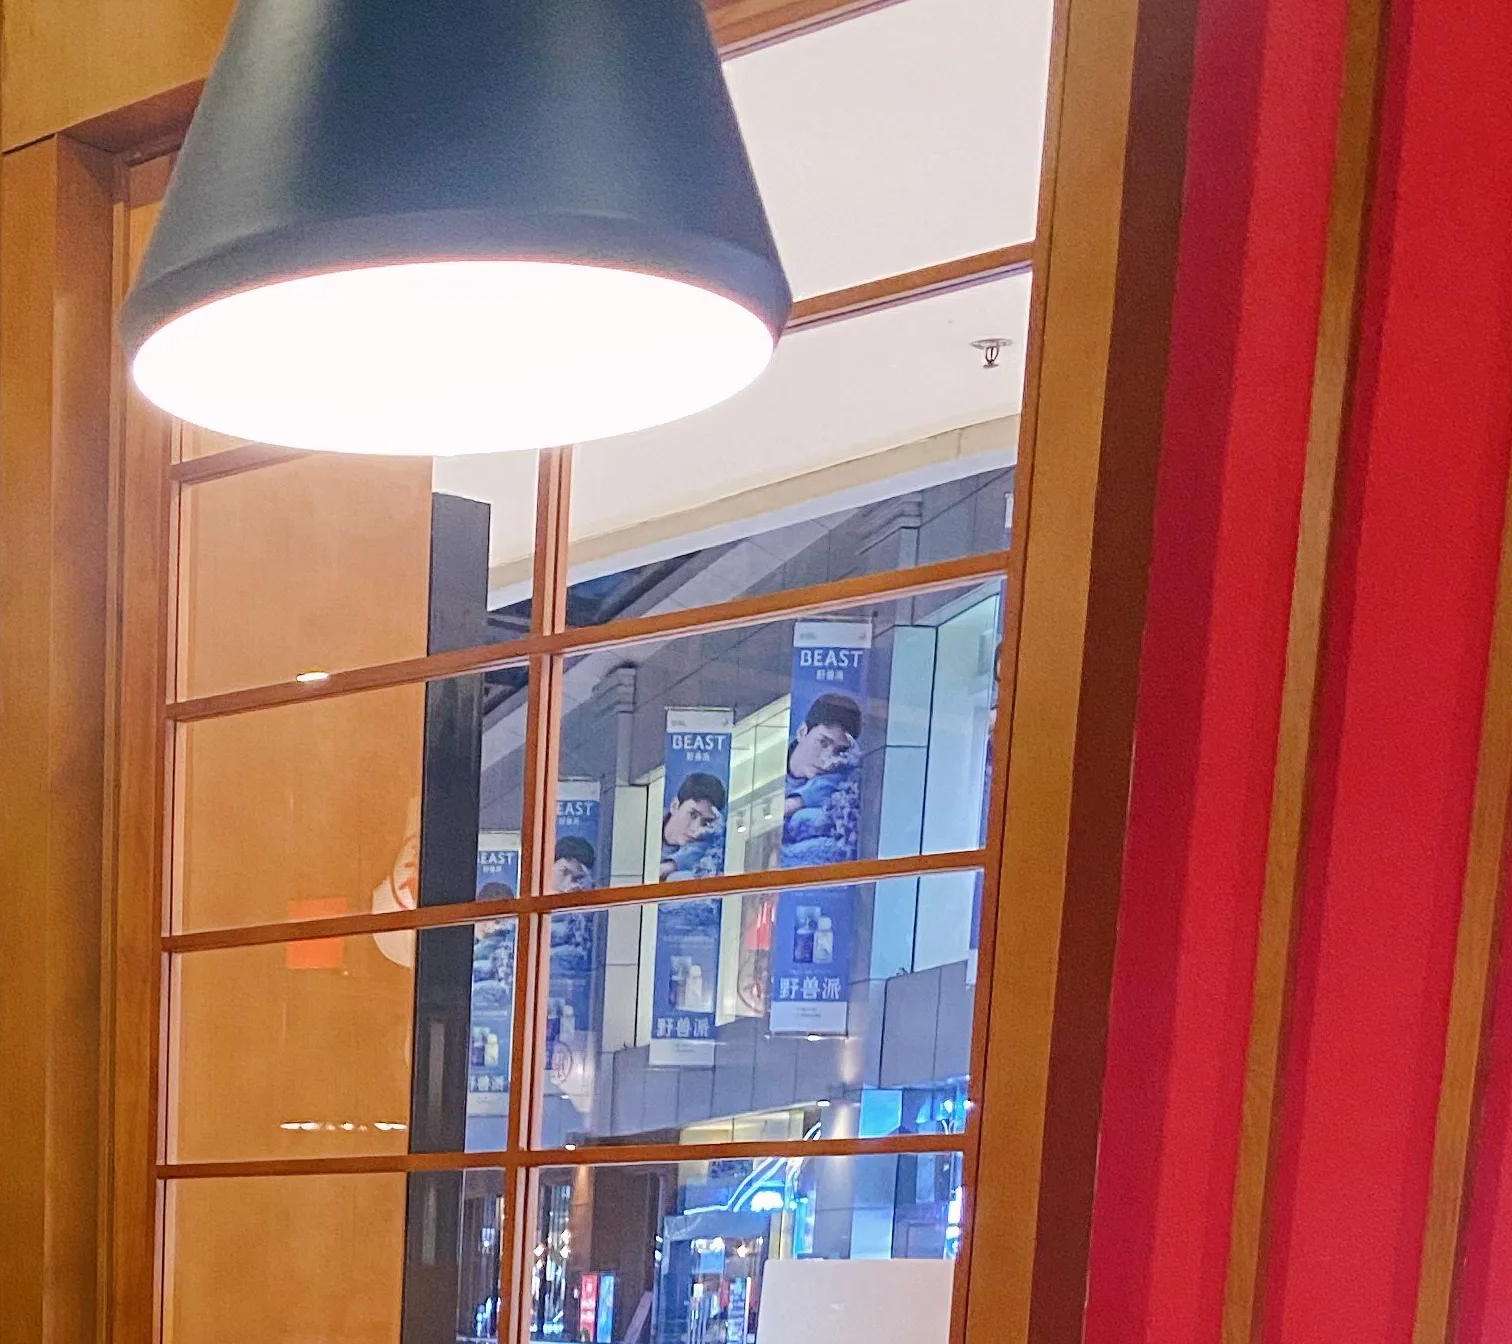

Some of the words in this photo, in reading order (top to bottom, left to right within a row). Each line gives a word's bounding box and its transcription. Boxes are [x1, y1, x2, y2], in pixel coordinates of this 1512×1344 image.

[800, 650, 863, 667] BEAST
[672, 735, 727, 750] BEAST
[557, 802, 593, 816] EAST
[478, 852, 513, 865] EAST
[779, 976, 841, 1000] 野兽派
